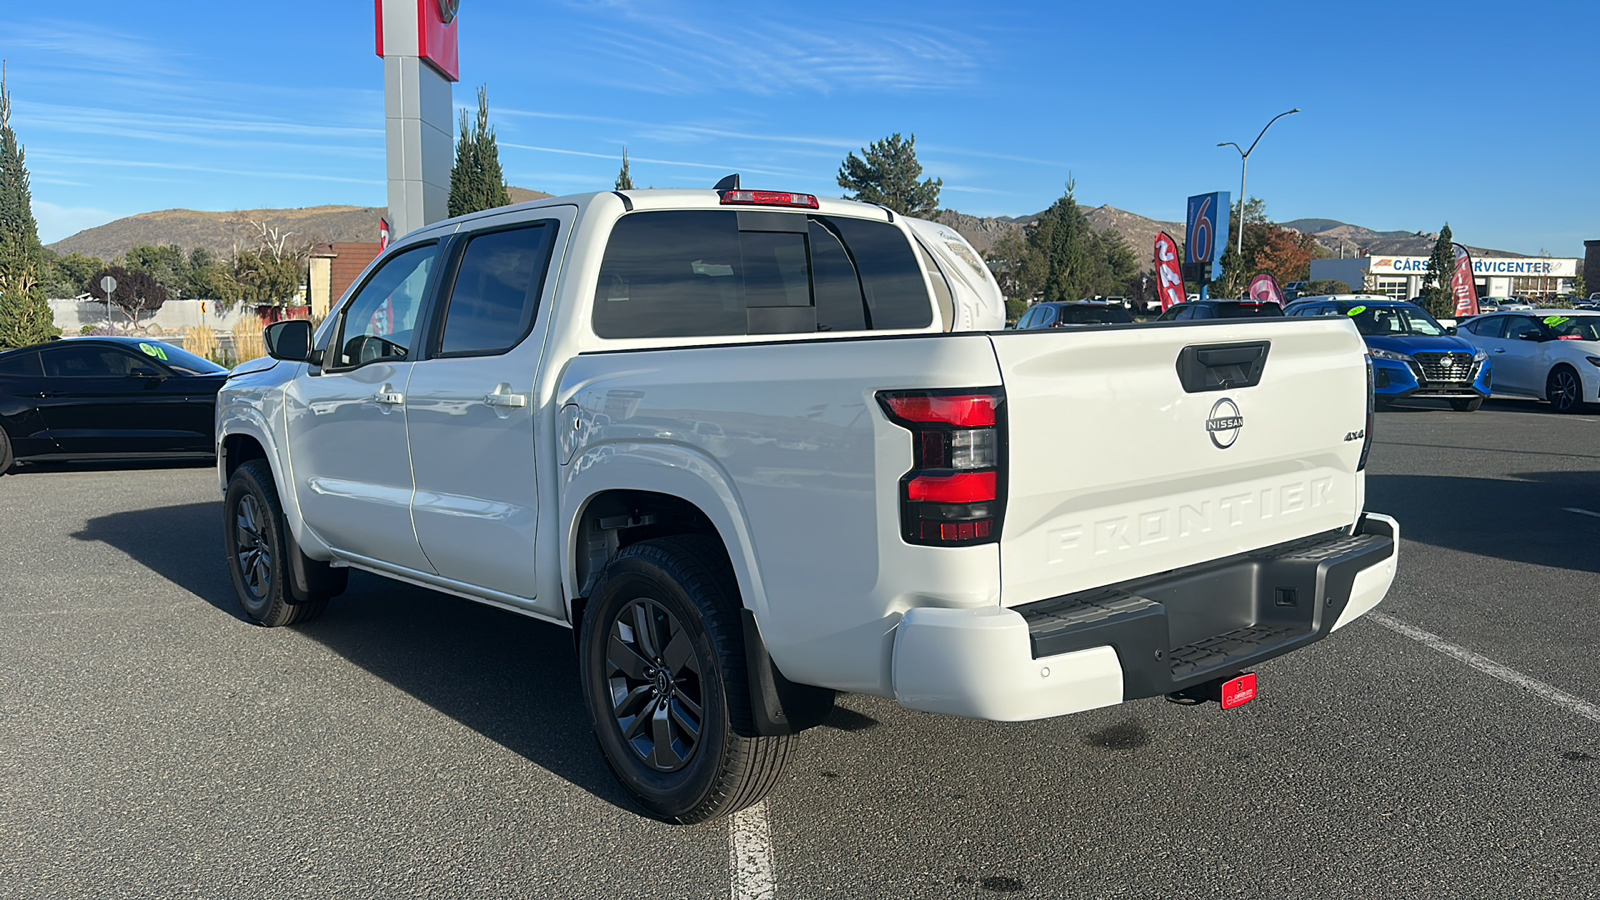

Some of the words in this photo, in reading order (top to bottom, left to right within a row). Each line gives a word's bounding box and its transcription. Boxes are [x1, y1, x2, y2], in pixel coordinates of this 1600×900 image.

[1192, 196, 1213, 263] 6
[1393, 259, 1430, 271] CARS
[1471, 261, 1551, 273] RVICENTER
[1208, 418, 1243, 429] NISSAN
[1047, 475, 1334, 564] FRONTIER
